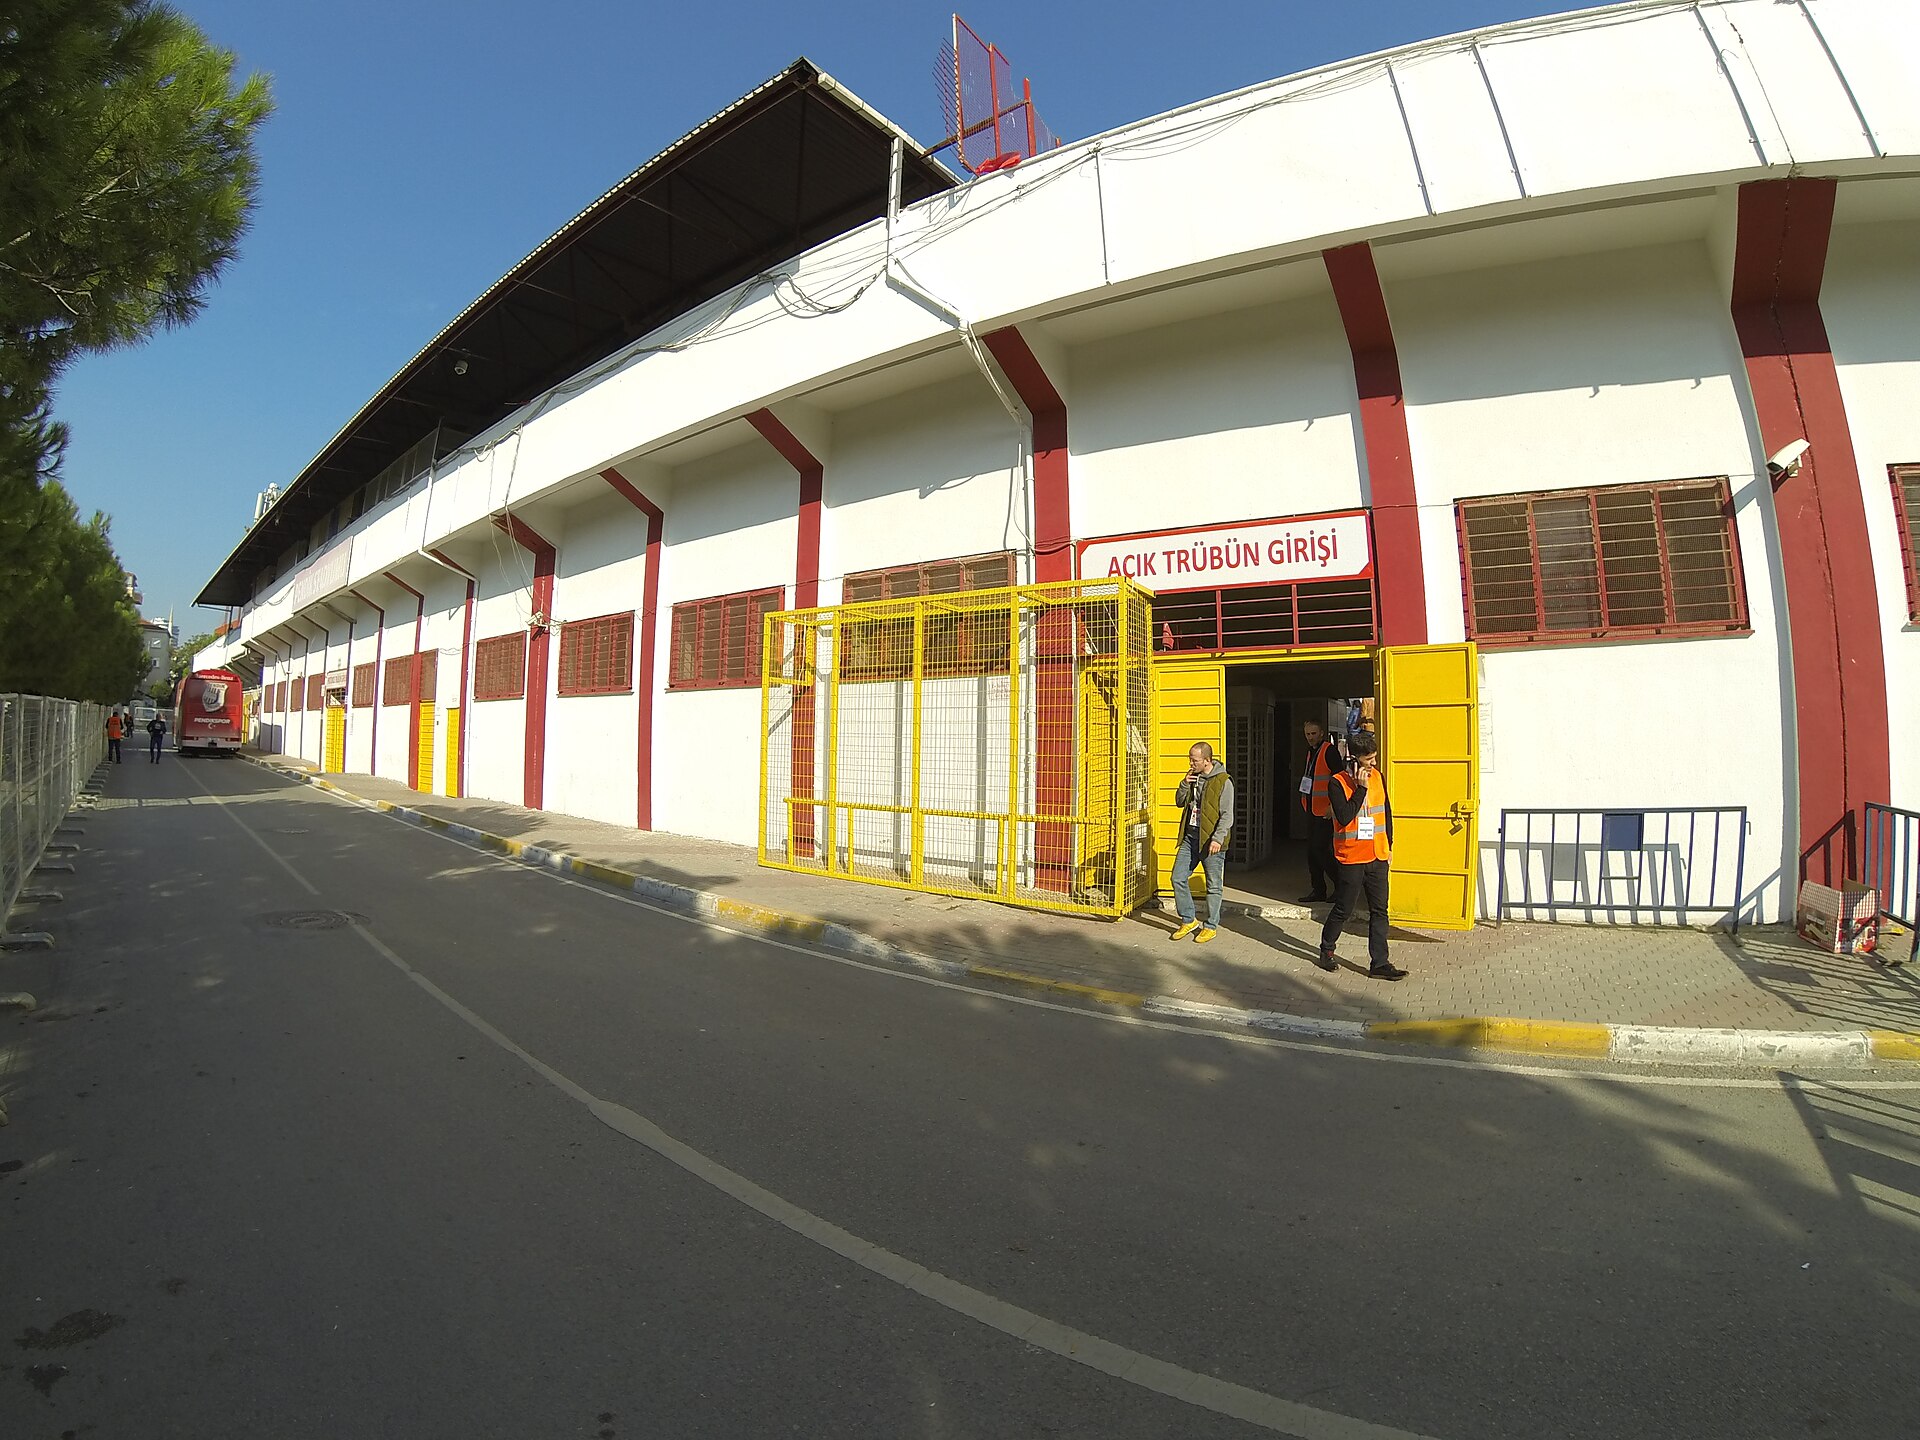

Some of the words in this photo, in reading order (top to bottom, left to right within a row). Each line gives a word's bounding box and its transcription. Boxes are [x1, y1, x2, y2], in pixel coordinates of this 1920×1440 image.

[1108, 552, 1157, 579] AÇIK
[1162, 537, 1260, 575] TRÜBÜN
[1267, 527, 1338, 568] GİRİŞİ
